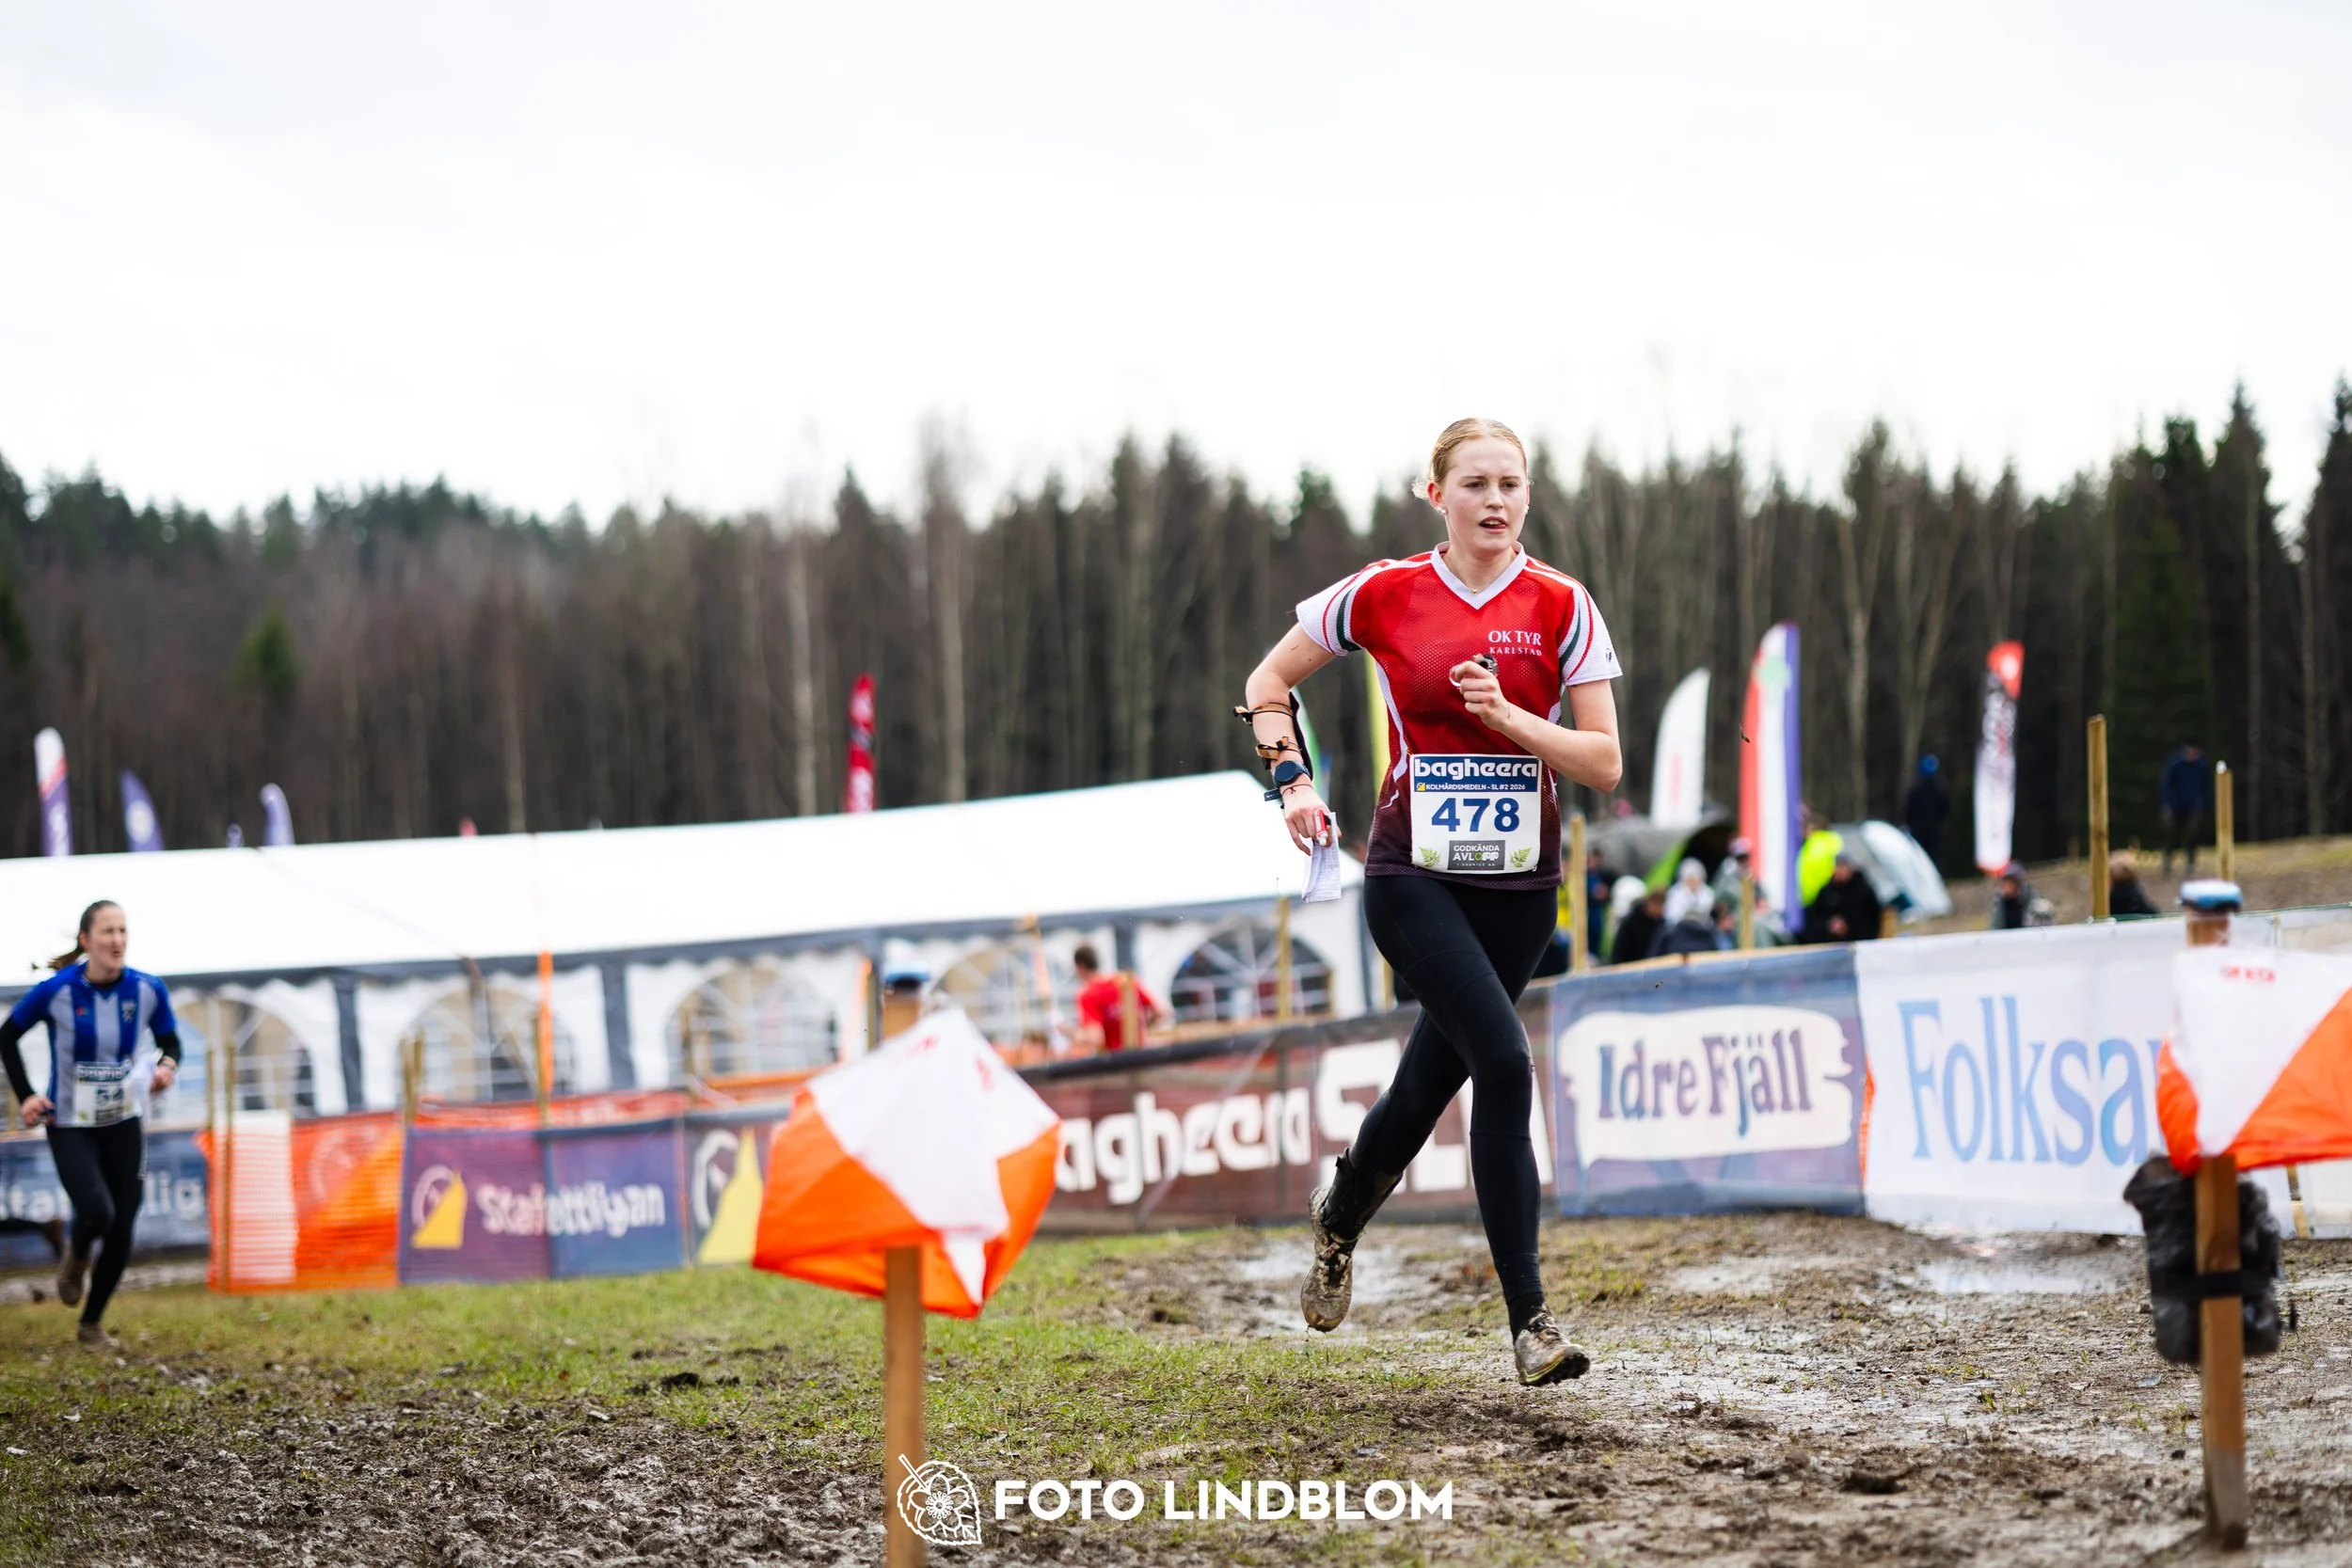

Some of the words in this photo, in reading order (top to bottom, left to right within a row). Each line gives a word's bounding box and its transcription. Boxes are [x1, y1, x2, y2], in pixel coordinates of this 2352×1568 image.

[1488, 630, 1511, 643] OK
[1515, 630, 1541, 646] TYR
[1489, 646, 1542, 657] KARLSTAD
[1415, 759, 1537, 780] bagheera
[1432, 798, 1519, 832] 478
[1454, 844, 1500, 852] GODKÄNDA
[1599, 1044, 1696, 1120] Idre
[1701, 1028, 1812, 1136] Fjäll
[1059, 1087, 1311, 1205] agheera
